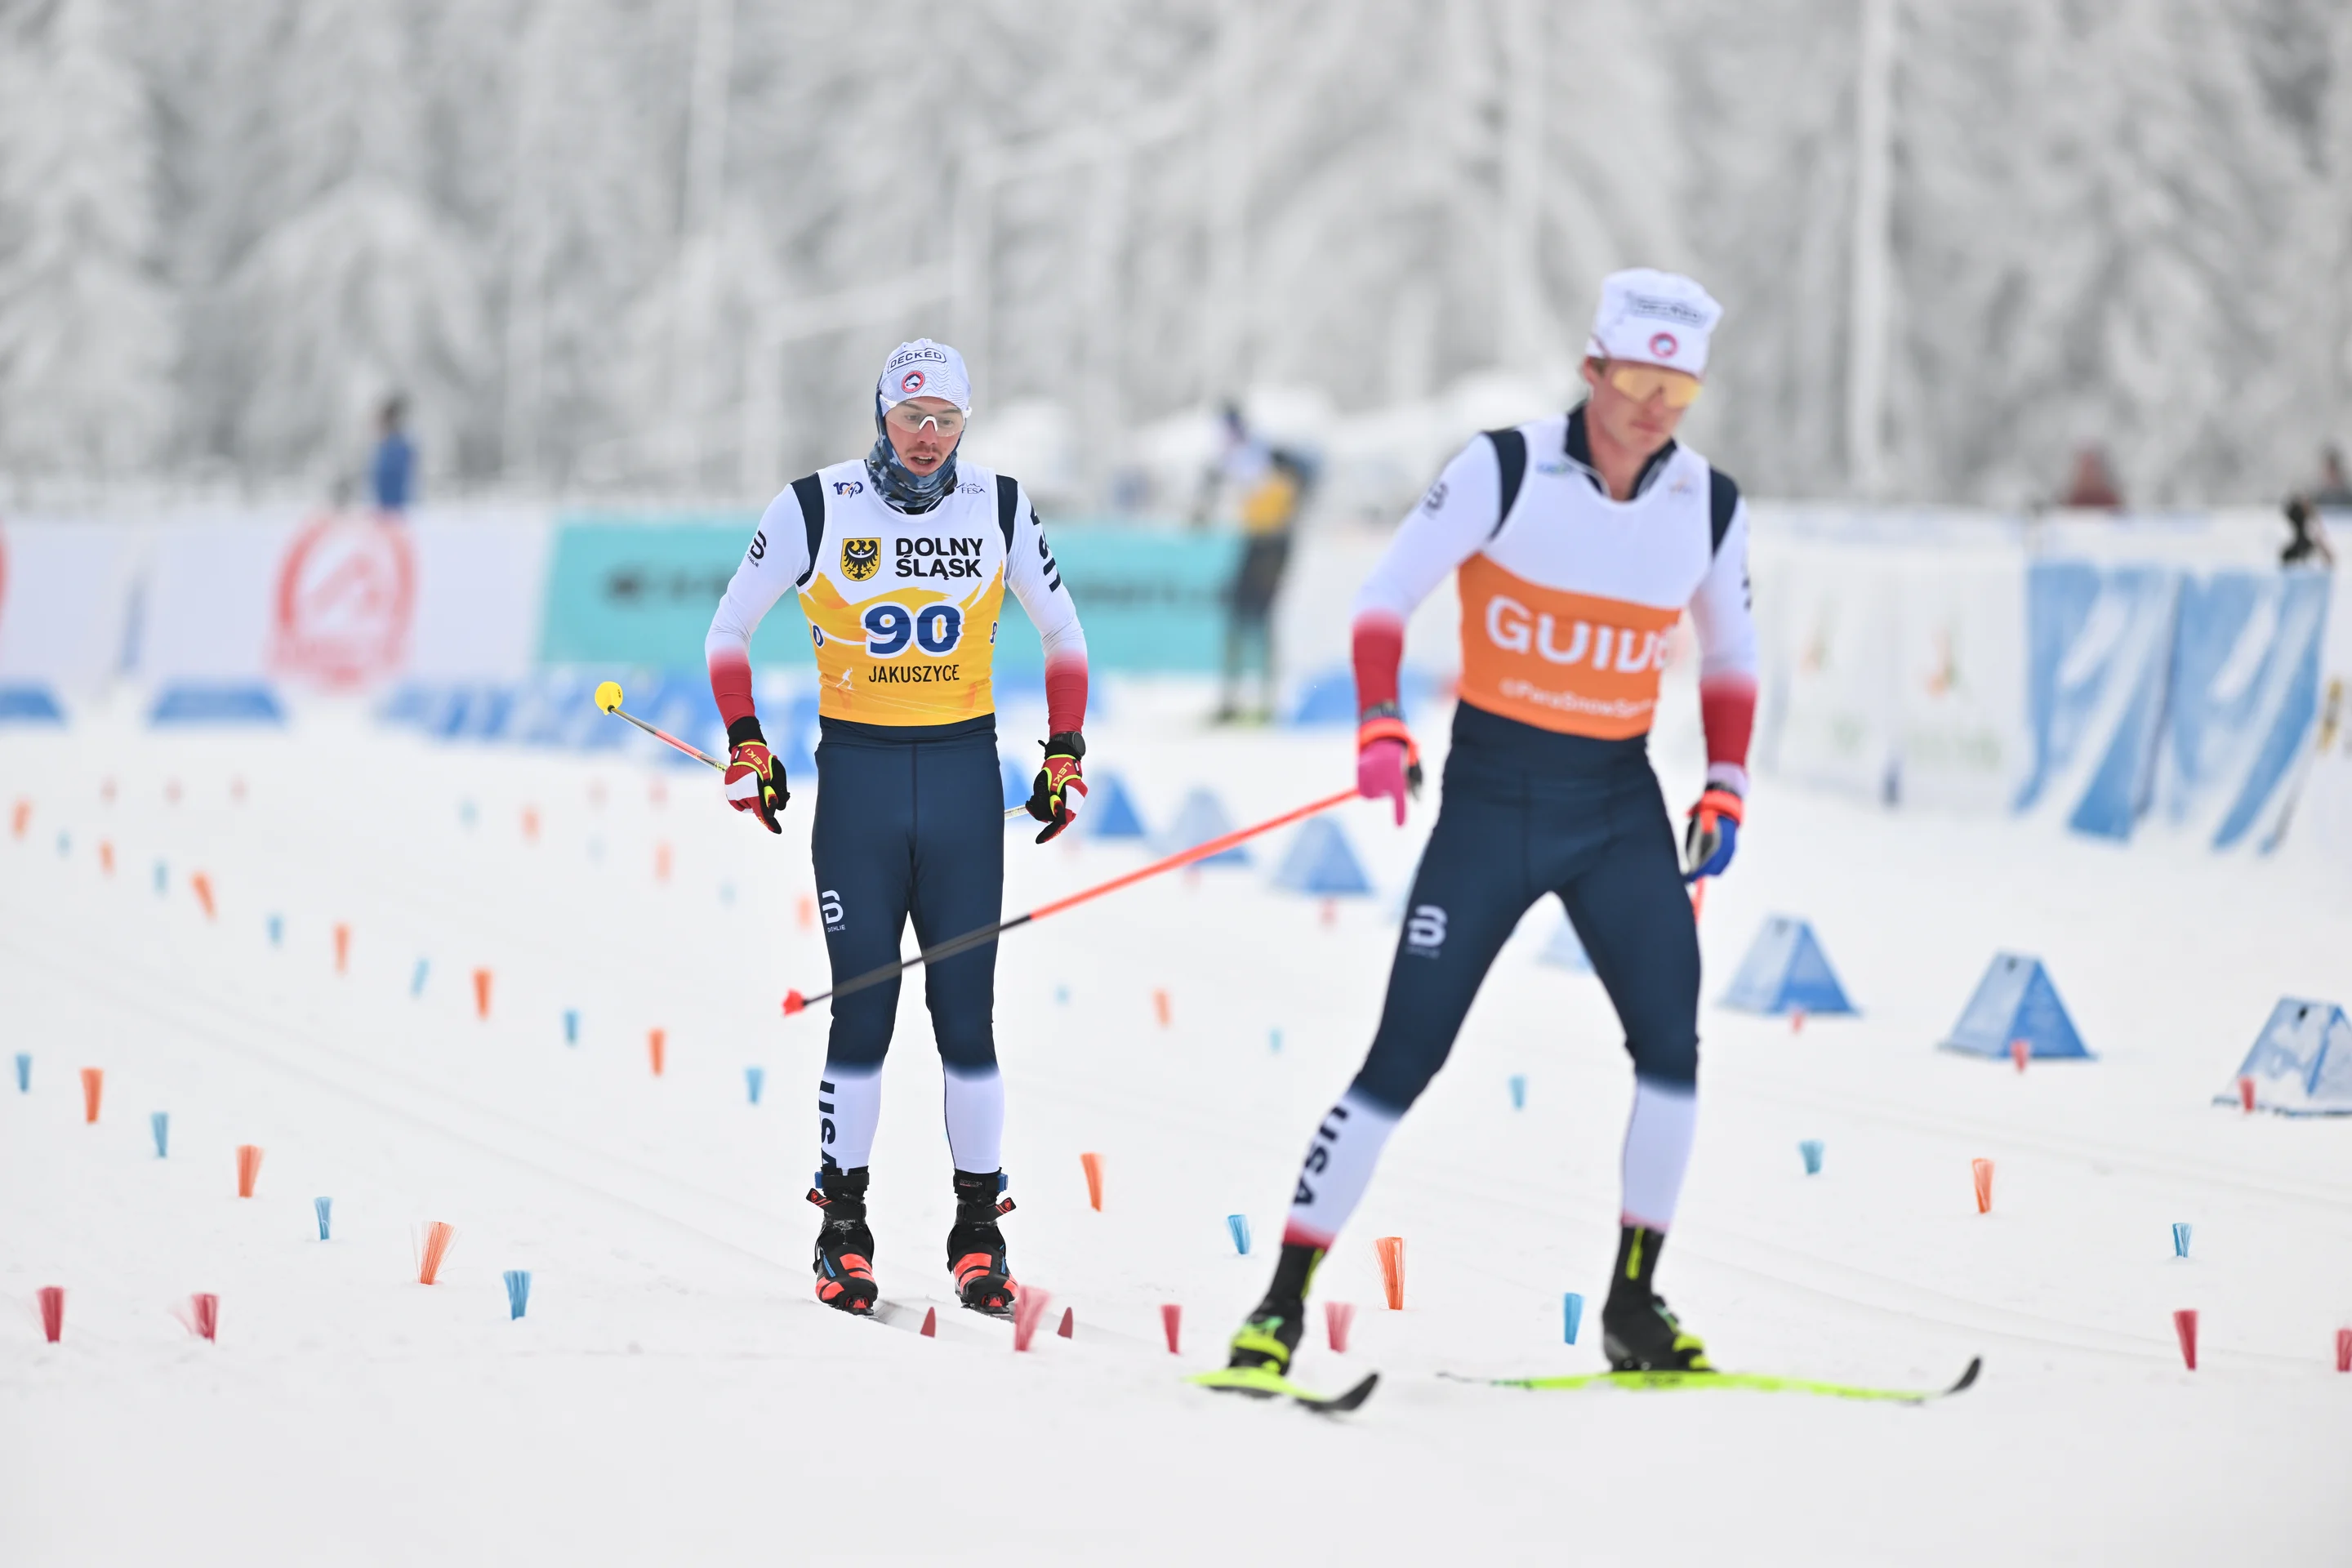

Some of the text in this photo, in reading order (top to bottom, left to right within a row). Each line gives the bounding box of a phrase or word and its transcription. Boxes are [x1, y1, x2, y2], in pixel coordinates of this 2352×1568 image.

[890, 351, 942, 368] DECKED
[896, 537, 983, 556] DOLNY
[895, 555, 982, 581] ŚLĄSK
[862, 603, 963, 657] 90
[868, 665, 960, 684] JAKUSZYCE
[745, 748, 768, 774] LEKI
[1052, 761, 1072, 787] LEKI
[1291, 1107, 1348, 1205] USA
